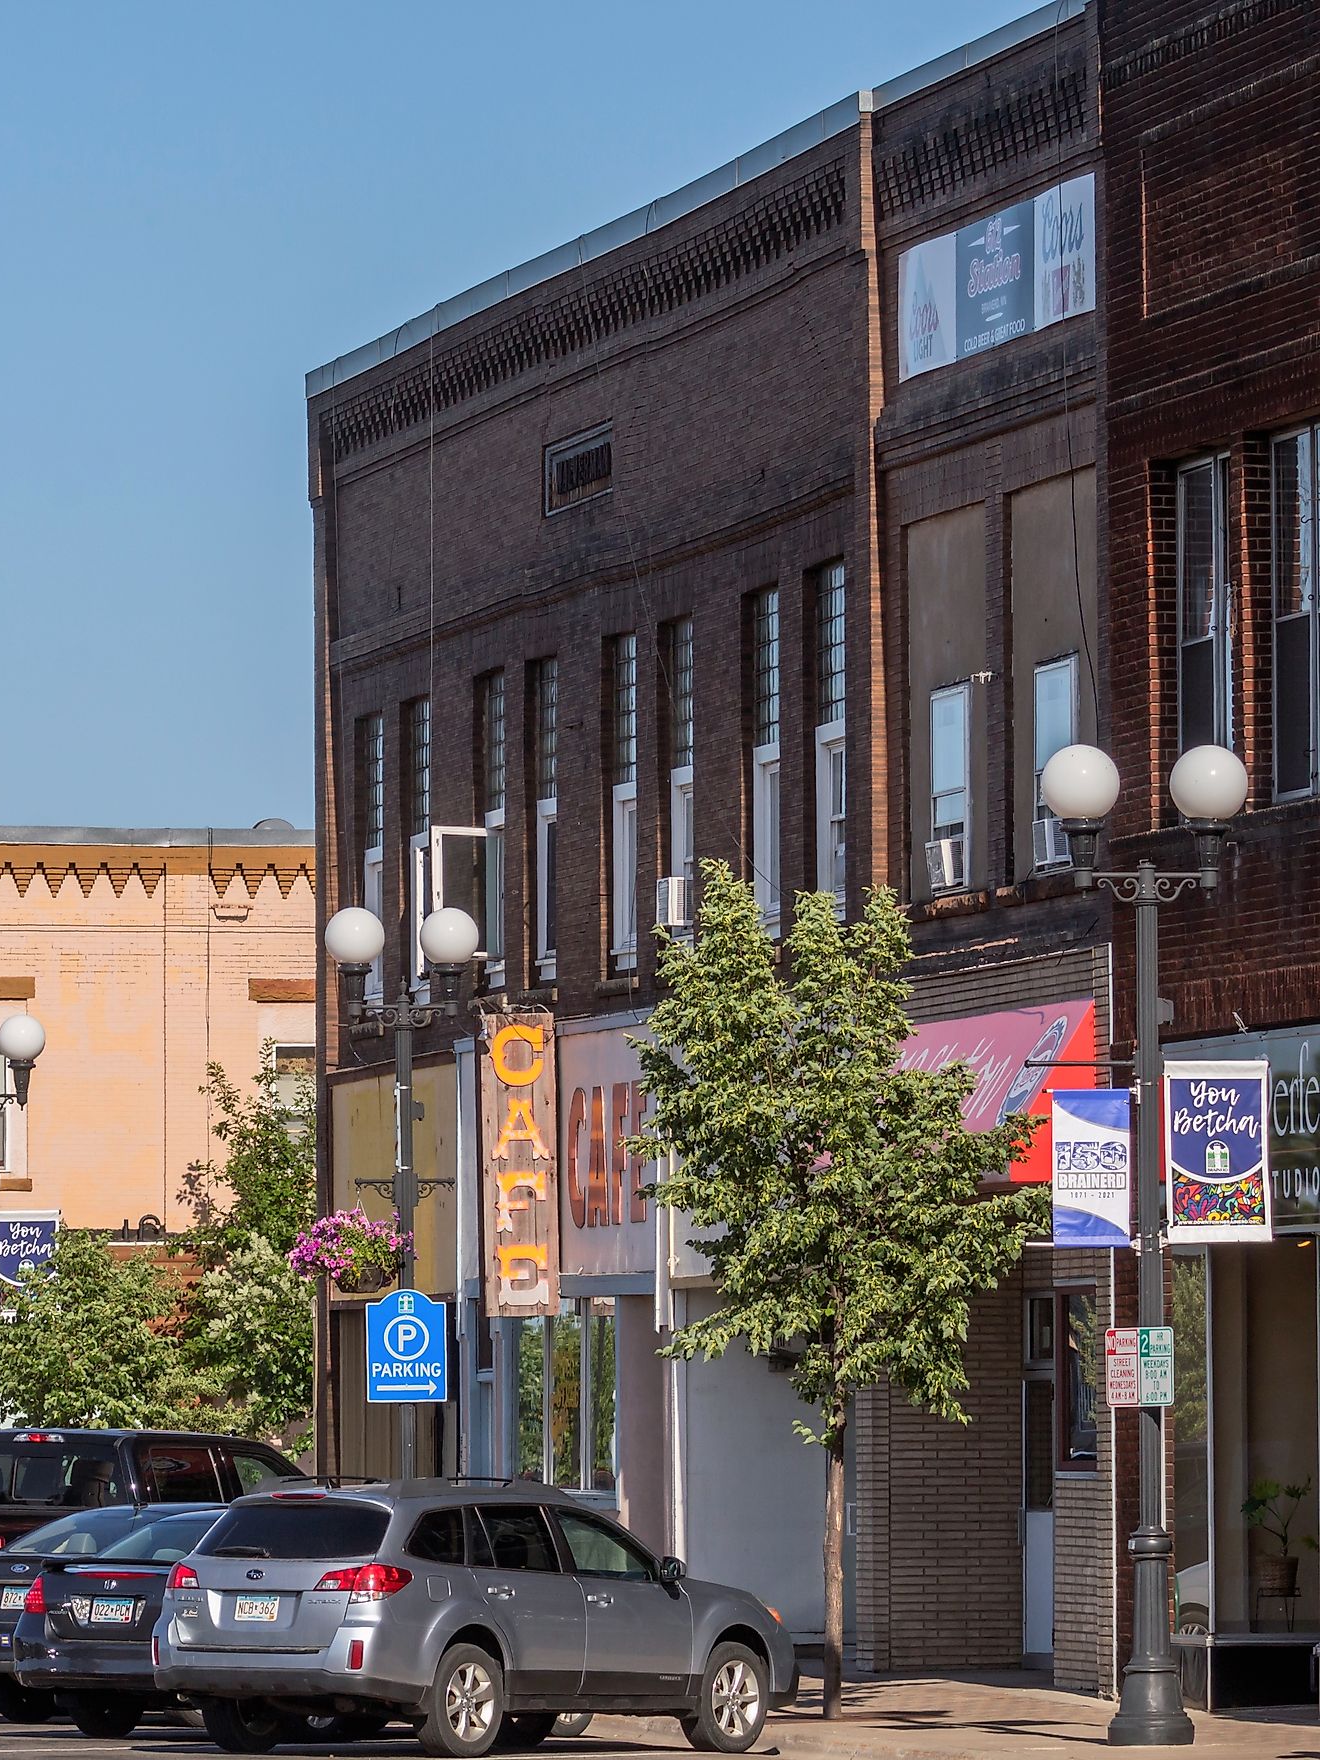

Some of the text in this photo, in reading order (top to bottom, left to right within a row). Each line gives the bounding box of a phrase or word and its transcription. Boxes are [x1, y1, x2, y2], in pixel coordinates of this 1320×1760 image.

[968, 249, 1020, 297] Station
[1190, 1080, 1240, 1108] You
[1173, 1105, 1259, 1139] Betcha
[568, 1080, 647, 1229] CAFE
[1055, 1141, 1127, 1170] 150
[490, 1024, 549, 1308] CAFE
[1058, 1173, 1126, 1189] BRAINERD
[1271, 1165, 1320, 1200] TUDIO
[9, 1222, 42, 1239] You
[1107, 1335, 1136, 1351] NO PARKING
[1141, 1331, 1164, 1353] 2 HR
[1150, 1344, 1170, 1353] PARKING
[372, 1362, 442, 1378] PARKING
[1113, 1358, 1131, 1367] STREET
[1144, 1360, 1169, 1369] WEEKDAYS
[1110, 1369, 1135, 1379] CLEANING
[1109, 1380, 1136, 1389] WEDNESDAYS
[1153, 1381, 1160, 1390] TO
[3, 1592, 18, 1604] 872
[94, 1604, 109, 1616] 022
[237, 1602, 275, 1615] NCB 362
